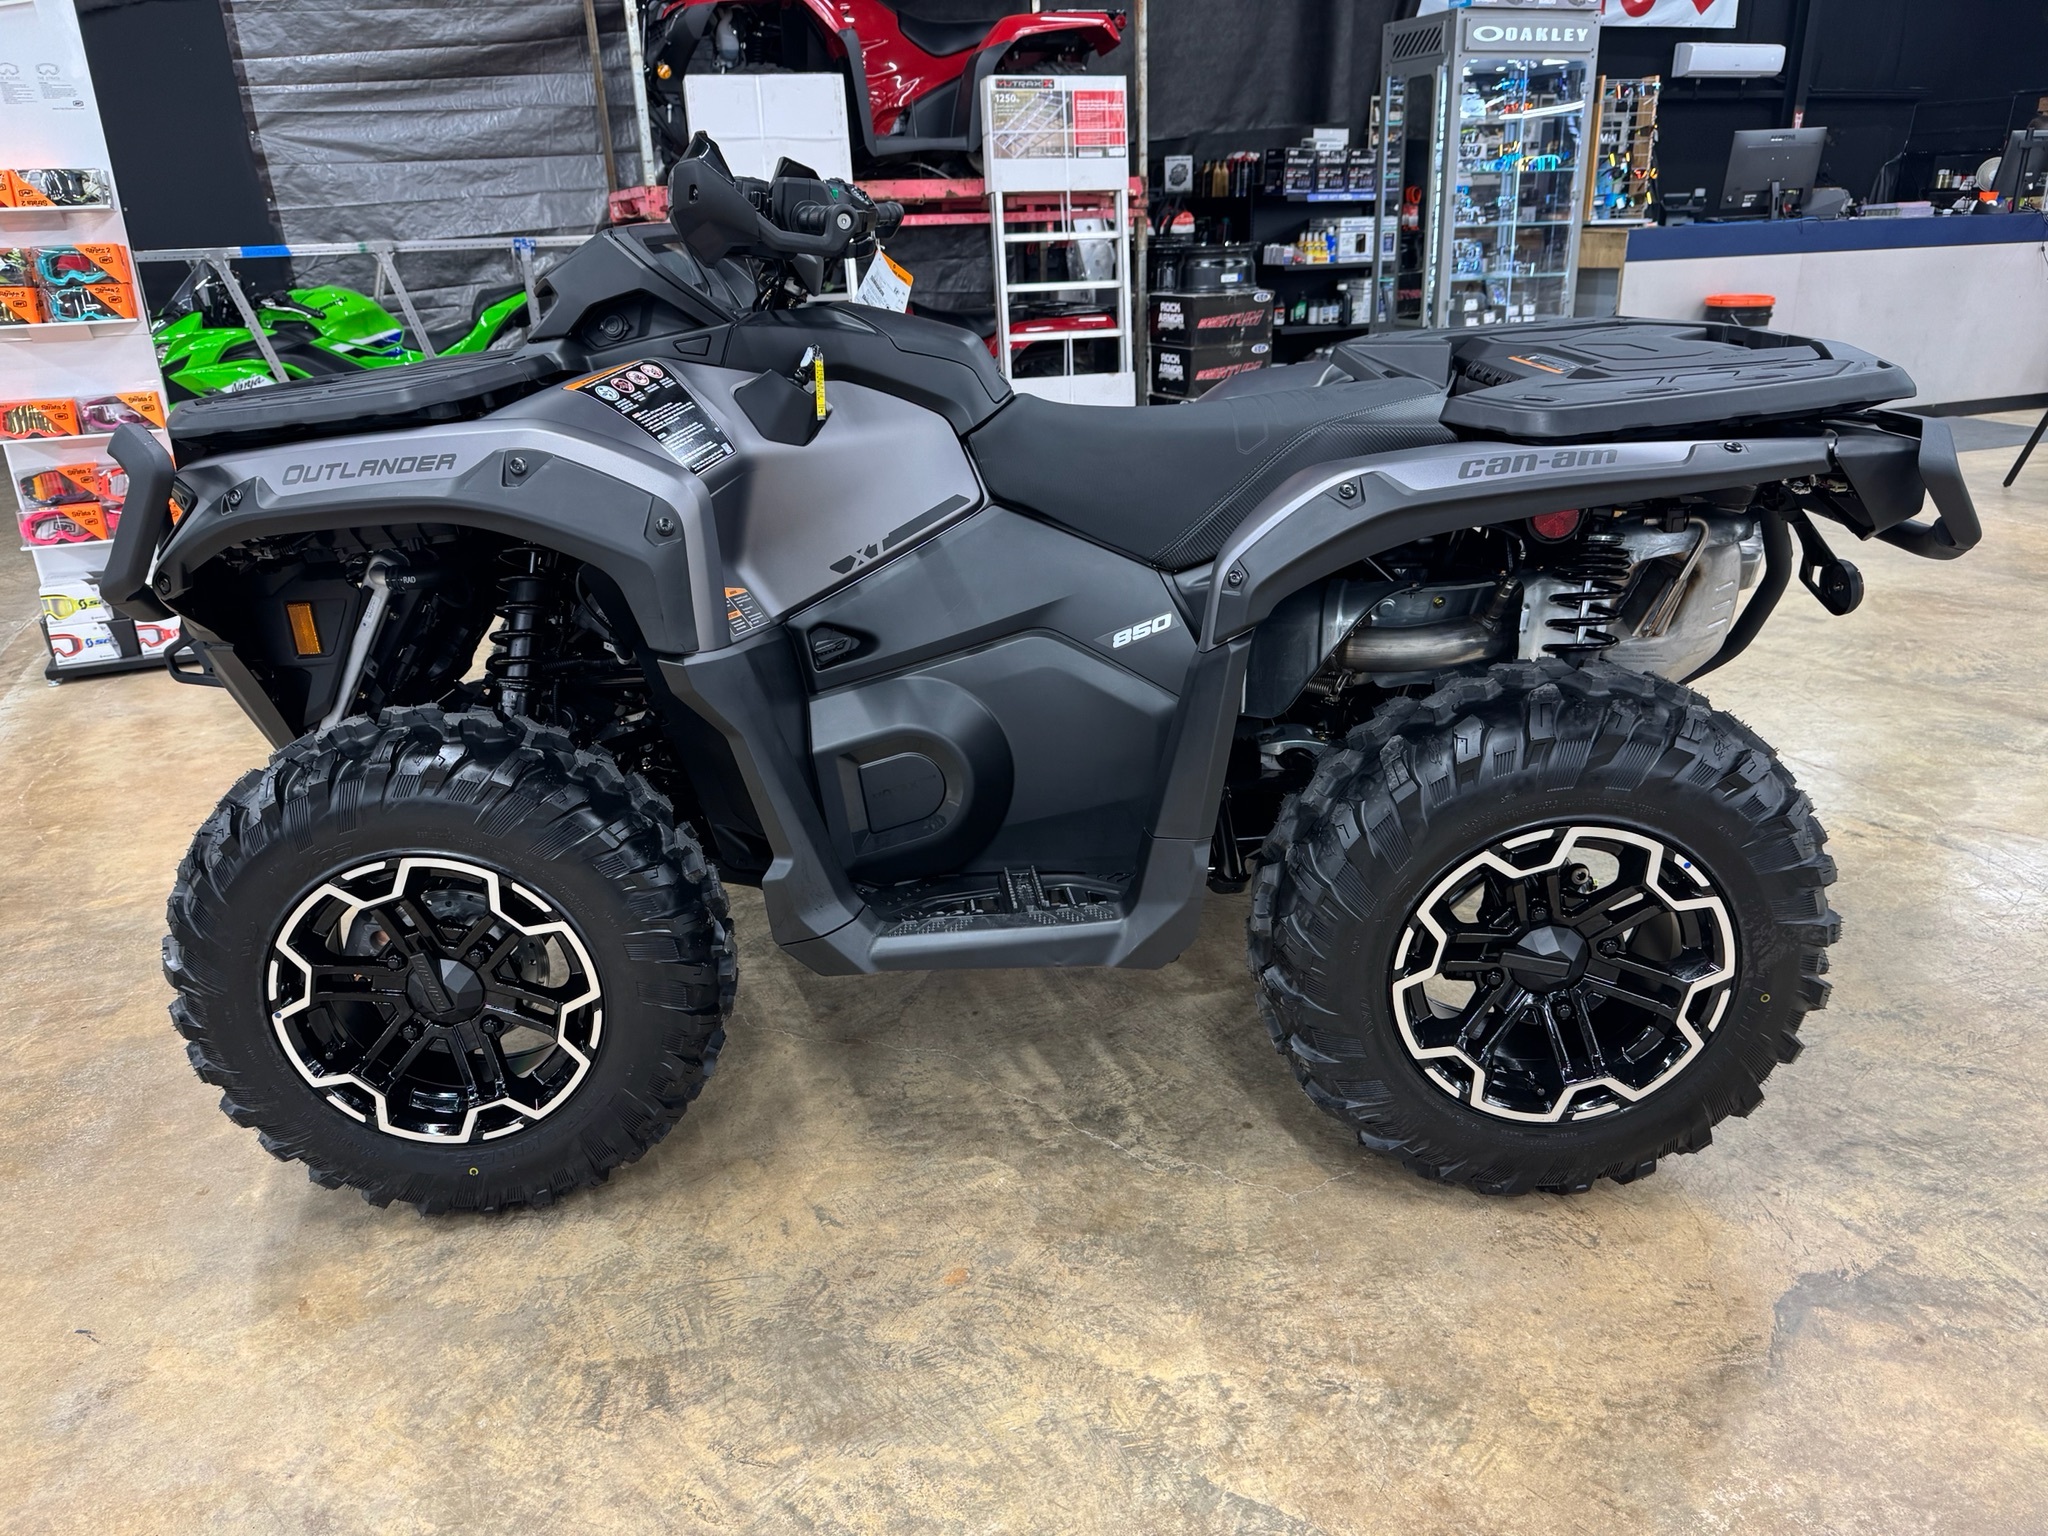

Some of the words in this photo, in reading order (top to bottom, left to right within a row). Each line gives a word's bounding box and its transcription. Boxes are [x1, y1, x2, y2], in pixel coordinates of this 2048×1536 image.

[1505, 27, 1589, 42] OAKLEY
[995, 94, 1016, 103] 1250
[231, 374, 265, 391] Ninja
[127, 395, 148, 404] Strata
[41, 403, 62, 411] Strata
[282, 453, 457, 486] OUTLANDER
[1457, 449, 1618, 480] can-am
[67, 468, 87, 476] Strata
[71, 510, 91, 518] Strata
[850, 533, 889, 573] XT
[402, 576, 416, 584] RAD
[1112, 613, 1172, 648] 850
